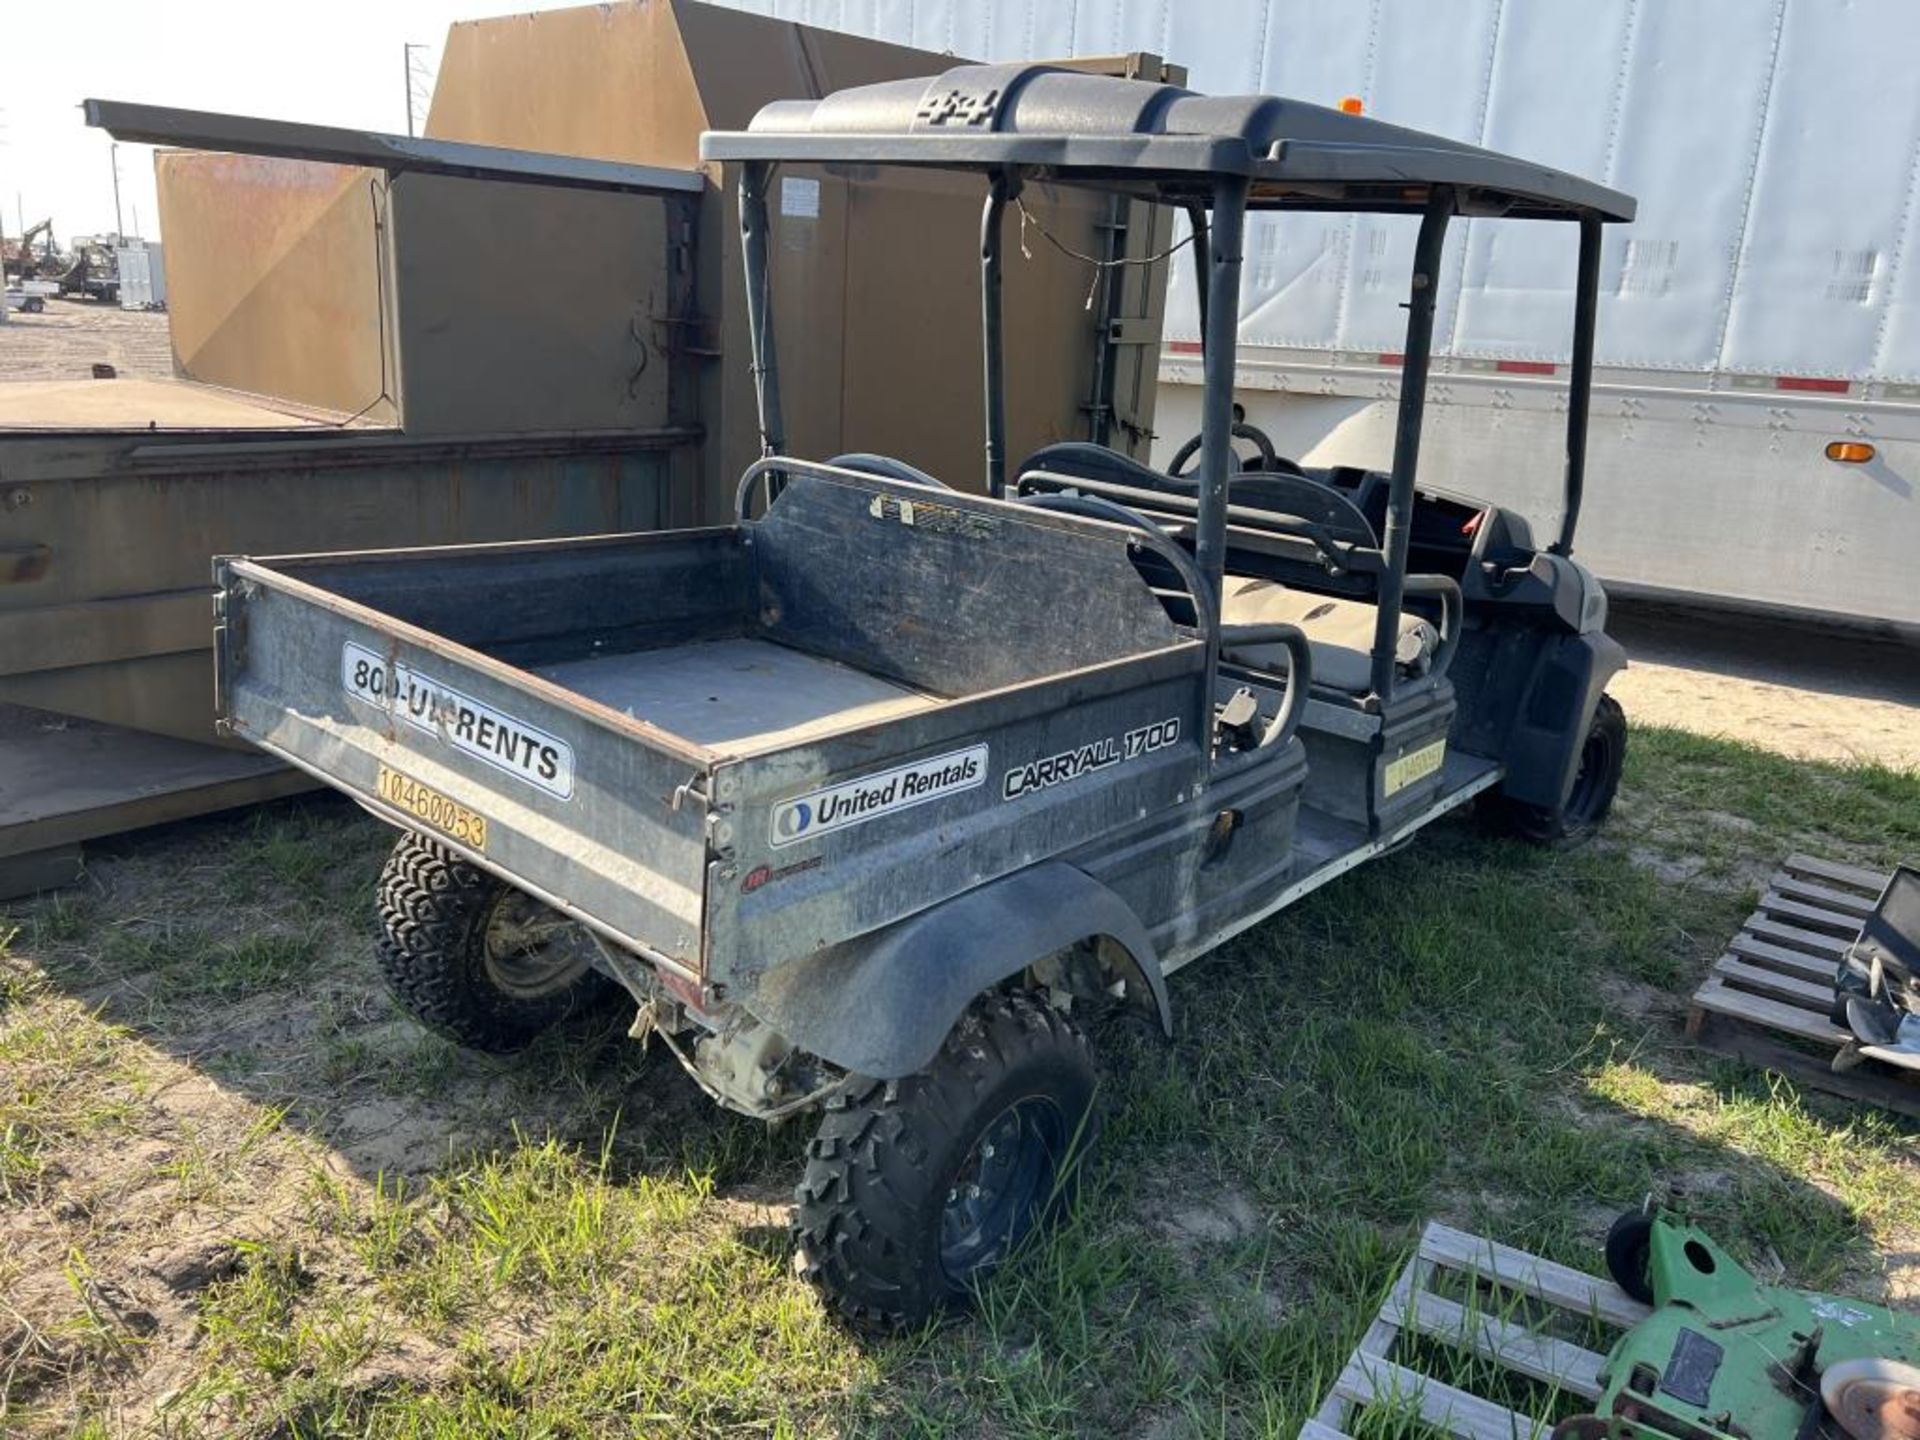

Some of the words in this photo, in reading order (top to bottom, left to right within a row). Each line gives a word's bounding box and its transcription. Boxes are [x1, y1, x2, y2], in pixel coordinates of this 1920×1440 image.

[817, 778, 898, 824] United
[901, 756, 978, 799] Rentals
[1003, 737, 1121, 800] CARRYALL
[1124, 717, 1181, 760] 1700
[381, 768, 484, 847] 10460053
